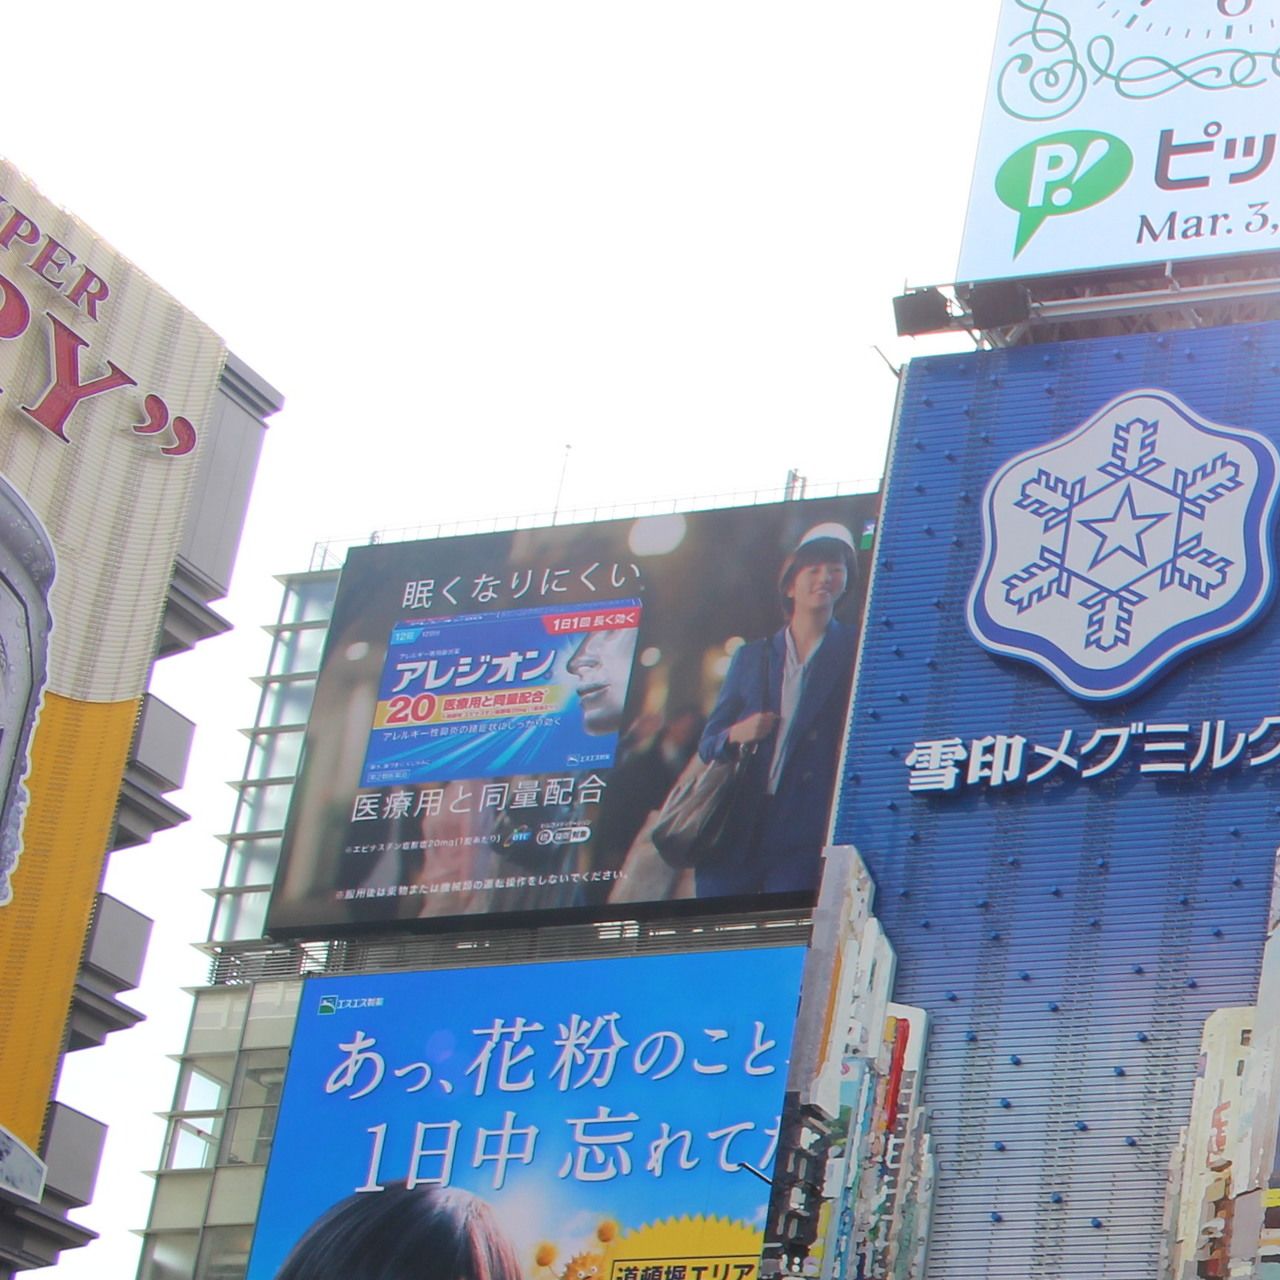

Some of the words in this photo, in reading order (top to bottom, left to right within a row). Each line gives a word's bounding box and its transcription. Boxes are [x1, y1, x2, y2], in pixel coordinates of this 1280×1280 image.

[1137, 213, 1232, 244] Mar.
[1245, 202, 1279, 235] 3,
[0, 194, 110, 322] PER
[402, 562, 641, 609] 眠くなりにくい
[392, 650, 556, 693] アレジオン
[385, 692, 437, 725] 20
[351, 774, 607, 824] 医療用と同量配合
